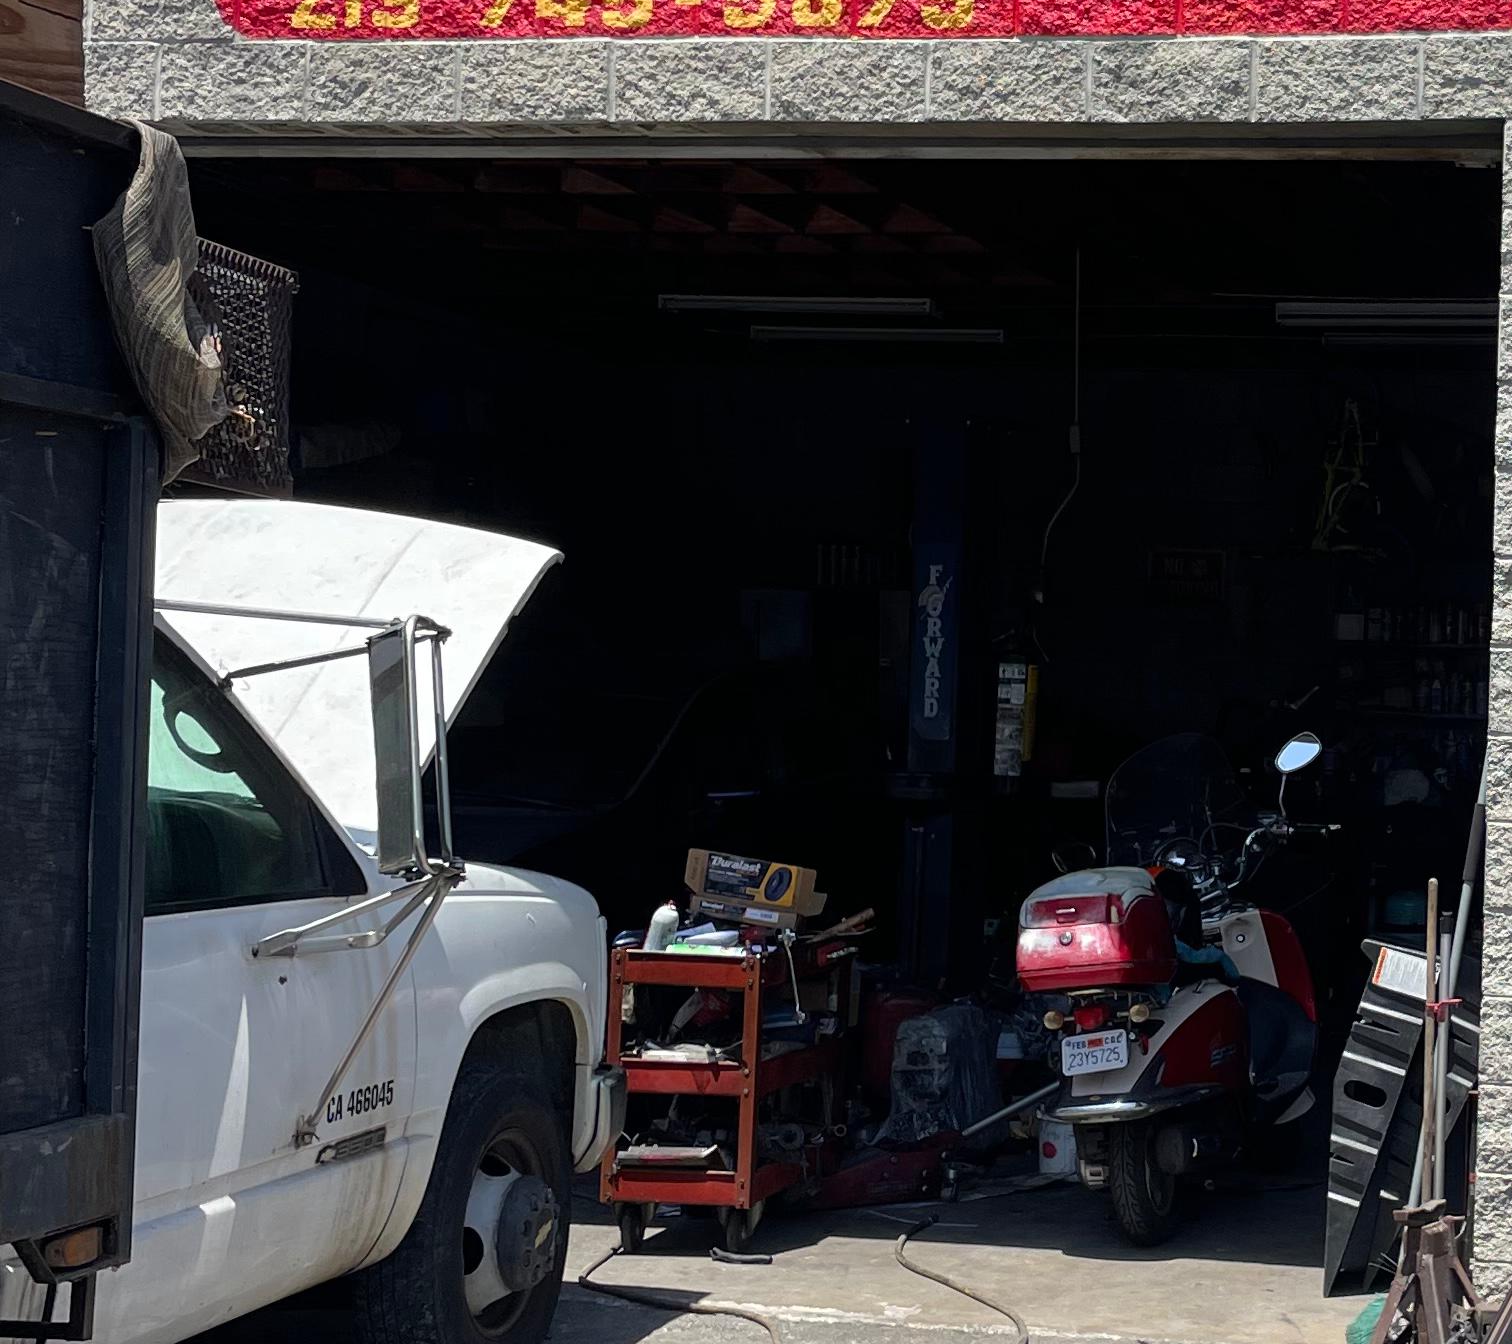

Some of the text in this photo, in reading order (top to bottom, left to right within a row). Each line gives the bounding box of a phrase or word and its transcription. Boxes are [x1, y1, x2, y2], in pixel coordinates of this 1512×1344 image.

[922, 563, 946, 719] FORWARD
[710, 855, 762, 876] Duralast
[1069, 1046, 1120, 1068] 23Y5725
[326, 1080, 394, 1123] CA 466045
